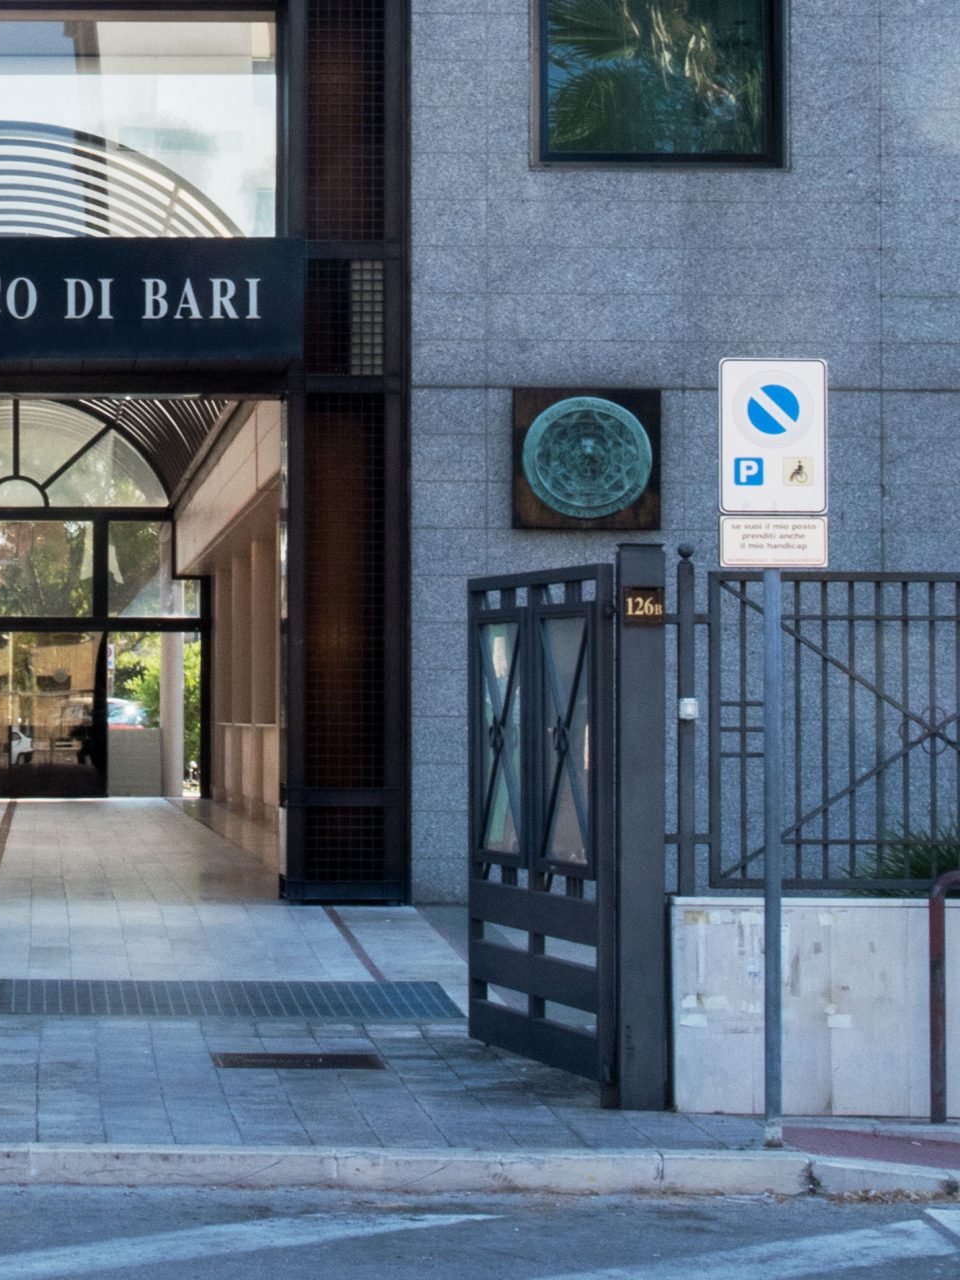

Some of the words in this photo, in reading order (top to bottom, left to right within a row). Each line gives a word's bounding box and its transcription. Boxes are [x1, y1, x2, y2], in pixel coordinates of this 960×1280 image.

[64, 277, 114, 320] DI
[142, 277, 262, 320] BARI
[739, 460, 759, 483] P
[792, 523, 816, 531] posto
[742, 532, 776, 540] prenditi
[767, 542, 807, 551] handicap
